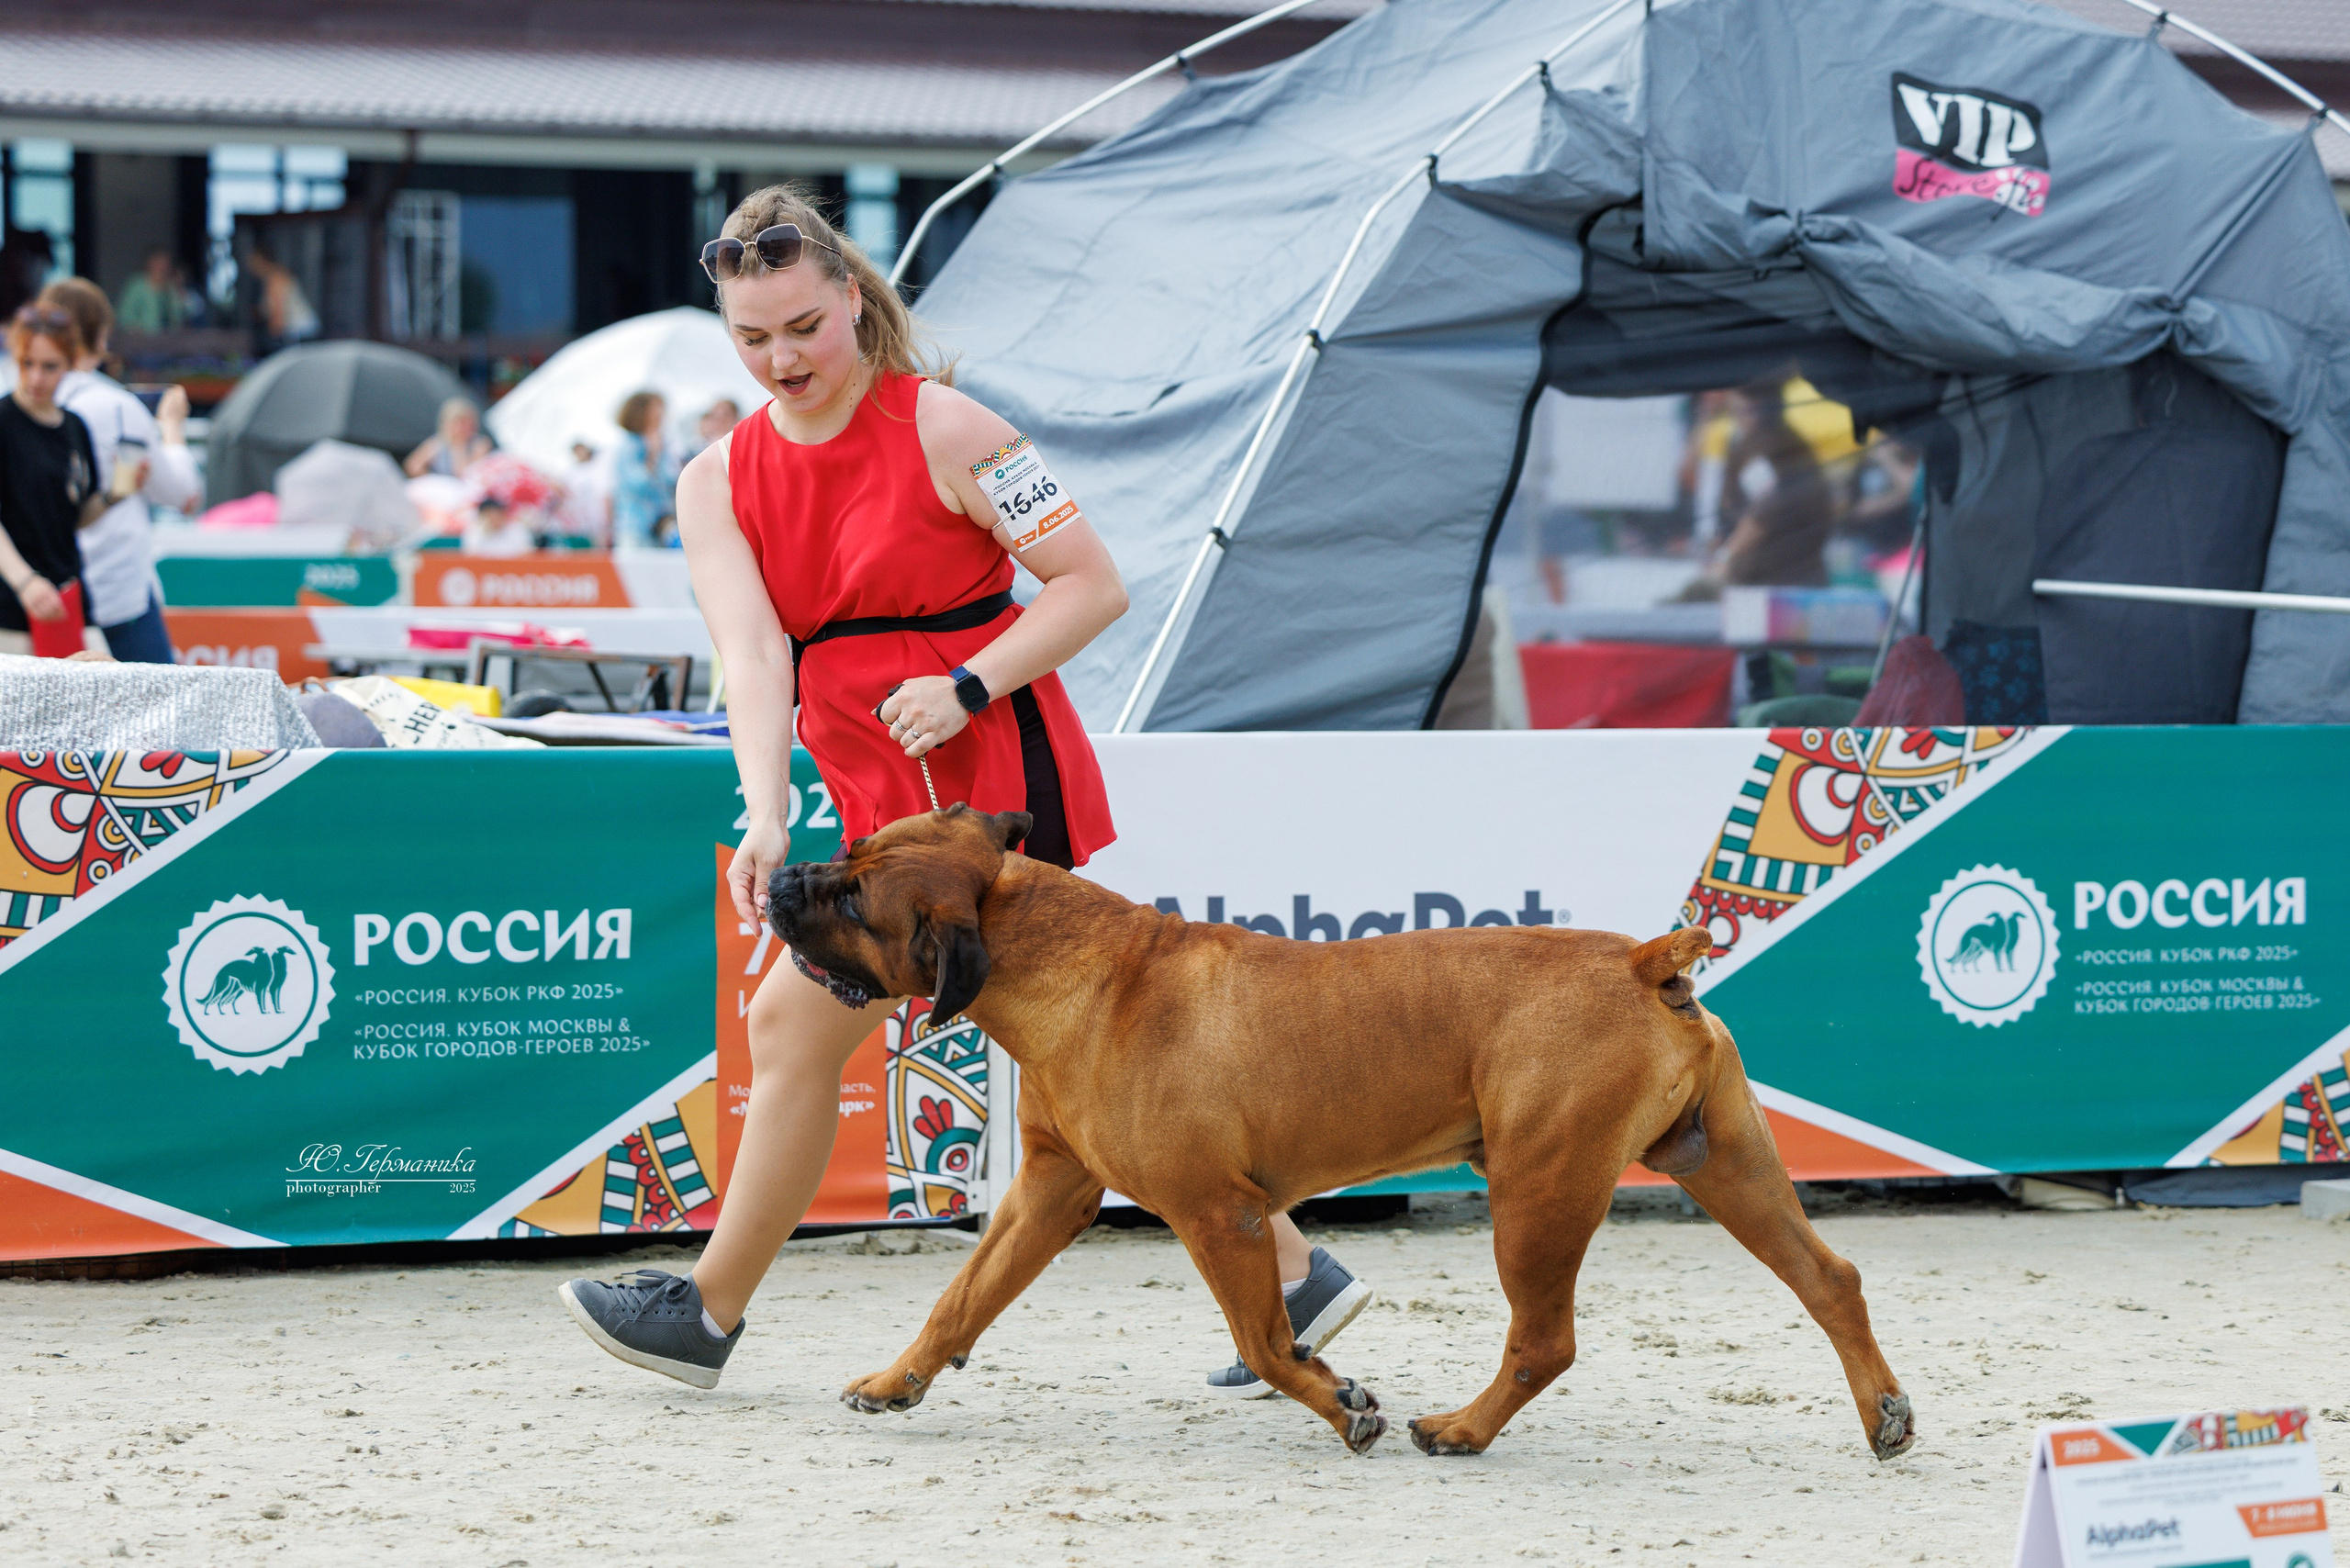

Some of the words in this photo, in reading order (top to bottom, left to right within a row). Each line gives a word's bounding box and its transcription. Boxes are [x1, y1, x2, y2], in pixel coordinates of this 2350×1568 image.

[1897, 83, 2036, 167] VIP
[1005, 455, 1028, 472] РОССИЯ
[999, 476, 1058, 521] 1646
[1043, 506, 1074, 529] 8.06.2025
[2074, 877, 2307, 929] РОССИЯ
[354, 908, 632, 966] РОССИЯ
[2160, 947, 2213, 963] КУБОК
[2218, 946, 2251, 961] РКФ
[355, 989, 451, 1005] «РОССИЯ.
[458, 986, 520, 1002] КУБОК
[527, 985, 565, 1001] РКФ
[571, 983, 623, 1000] 2025»
[2160, 979, 2213, 993] КУБОК
[2218, 977, 2288, 992] МОСКВЫ
[2293, 976, 2304, 990] &
[2075, 999, 2128, 1014] КУБОК
[354, 1023, 451, 1039] «РОССИЯ.
[457, 1021, 521, 1037] КУБОК
[528, 1018, 612, 1036] МОСКВЫ
[618, 1018, 631, 1033] &
[354, 1044, 418, 1060] КУБОК
[425, 1038, 594, 1058] ГОРОДОВ-ГЕРОЕВ
[599, 1036, 650, 1053] 2025»
[2087, 1518, 2179, 1547] AlphaPet
